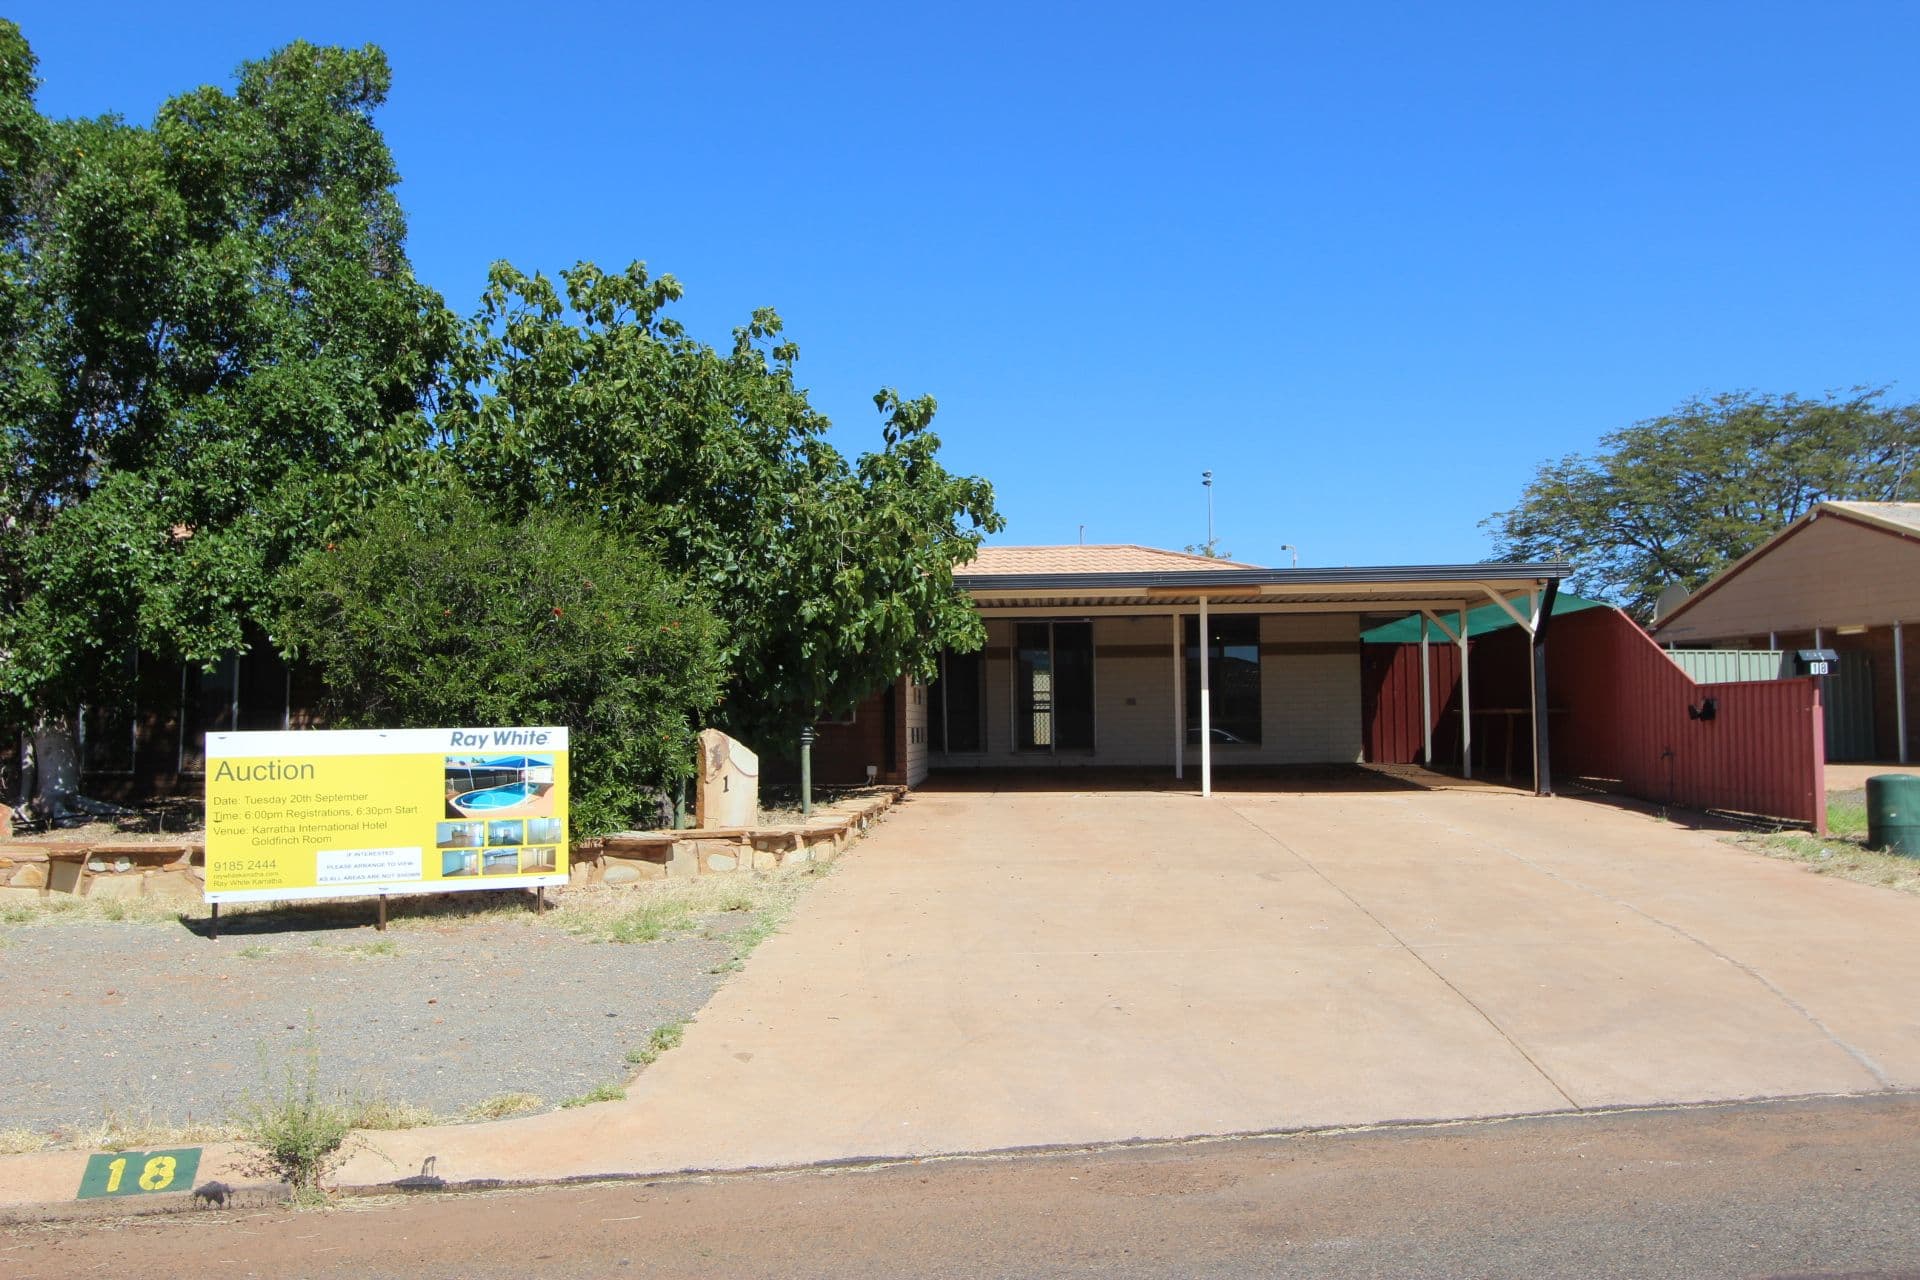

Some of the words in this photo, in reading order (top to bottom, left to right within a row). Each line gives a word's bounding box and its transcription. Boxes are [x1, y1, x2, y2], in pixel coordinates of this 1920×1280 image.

[450, 731, 488, 749] Ray
[494, 730, 548, 745] White
[214, 760, 314, 781] Auction
[213, 796, 240, 806] Date:
[245, 795, 286, 805] Tuesday
[290, 794, 312, 803] 20th
[315, 792, 368, 803] September
[244, 810, 283, 821] 6:00pm
[356, 806, 392, 816] 6:30pm
[395, 805, 418, 814] Start
[213, 826, 249, 836] Venue:
[252, 825, 295, 834] Karratha
[299, 821, 359, 833] International
[362, 821, 387, 831] Hotel
[251, 836, 299, 846] Goldfinch
[302, 835, 332, 844] Room
[213, 861, 243, 872] 9185
[247, 860, 276, 870] 2444
[252, 878, 282, 886] Karratha
[106, 1156, 177, 1192] 18
